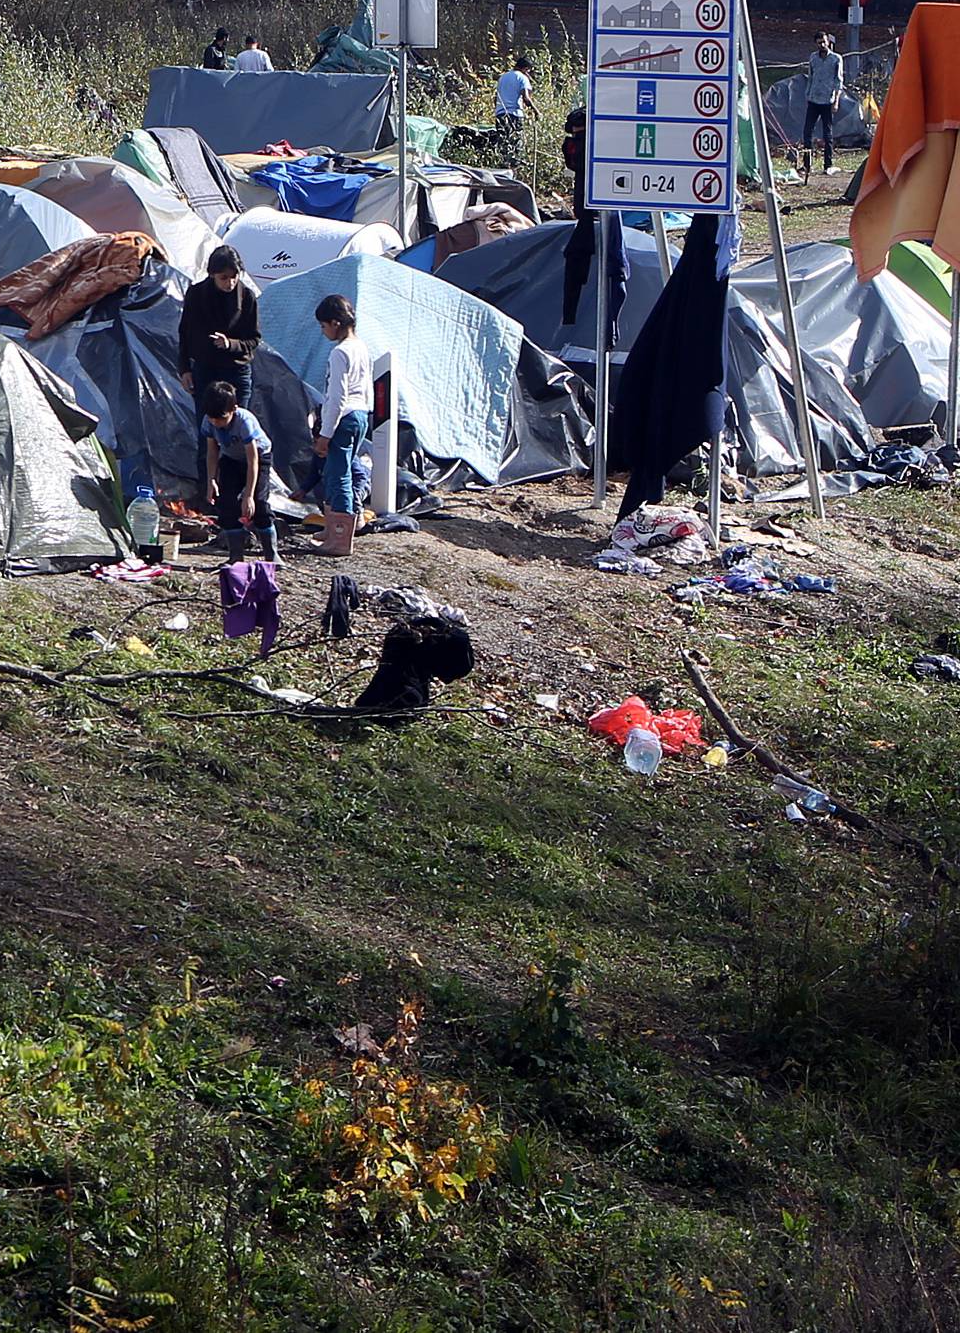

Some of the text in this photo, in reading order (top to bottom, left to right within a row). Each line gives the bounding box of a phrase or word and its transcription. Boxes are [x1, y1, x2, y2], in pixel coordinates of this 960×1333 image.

[702, 4, 721, 22] 50
[701, 47, 720, 65] 80
[699, 91, 720, 109] 100
[698, 134, 719, 152] 130
[642, 175, 675, 193] 0-24
